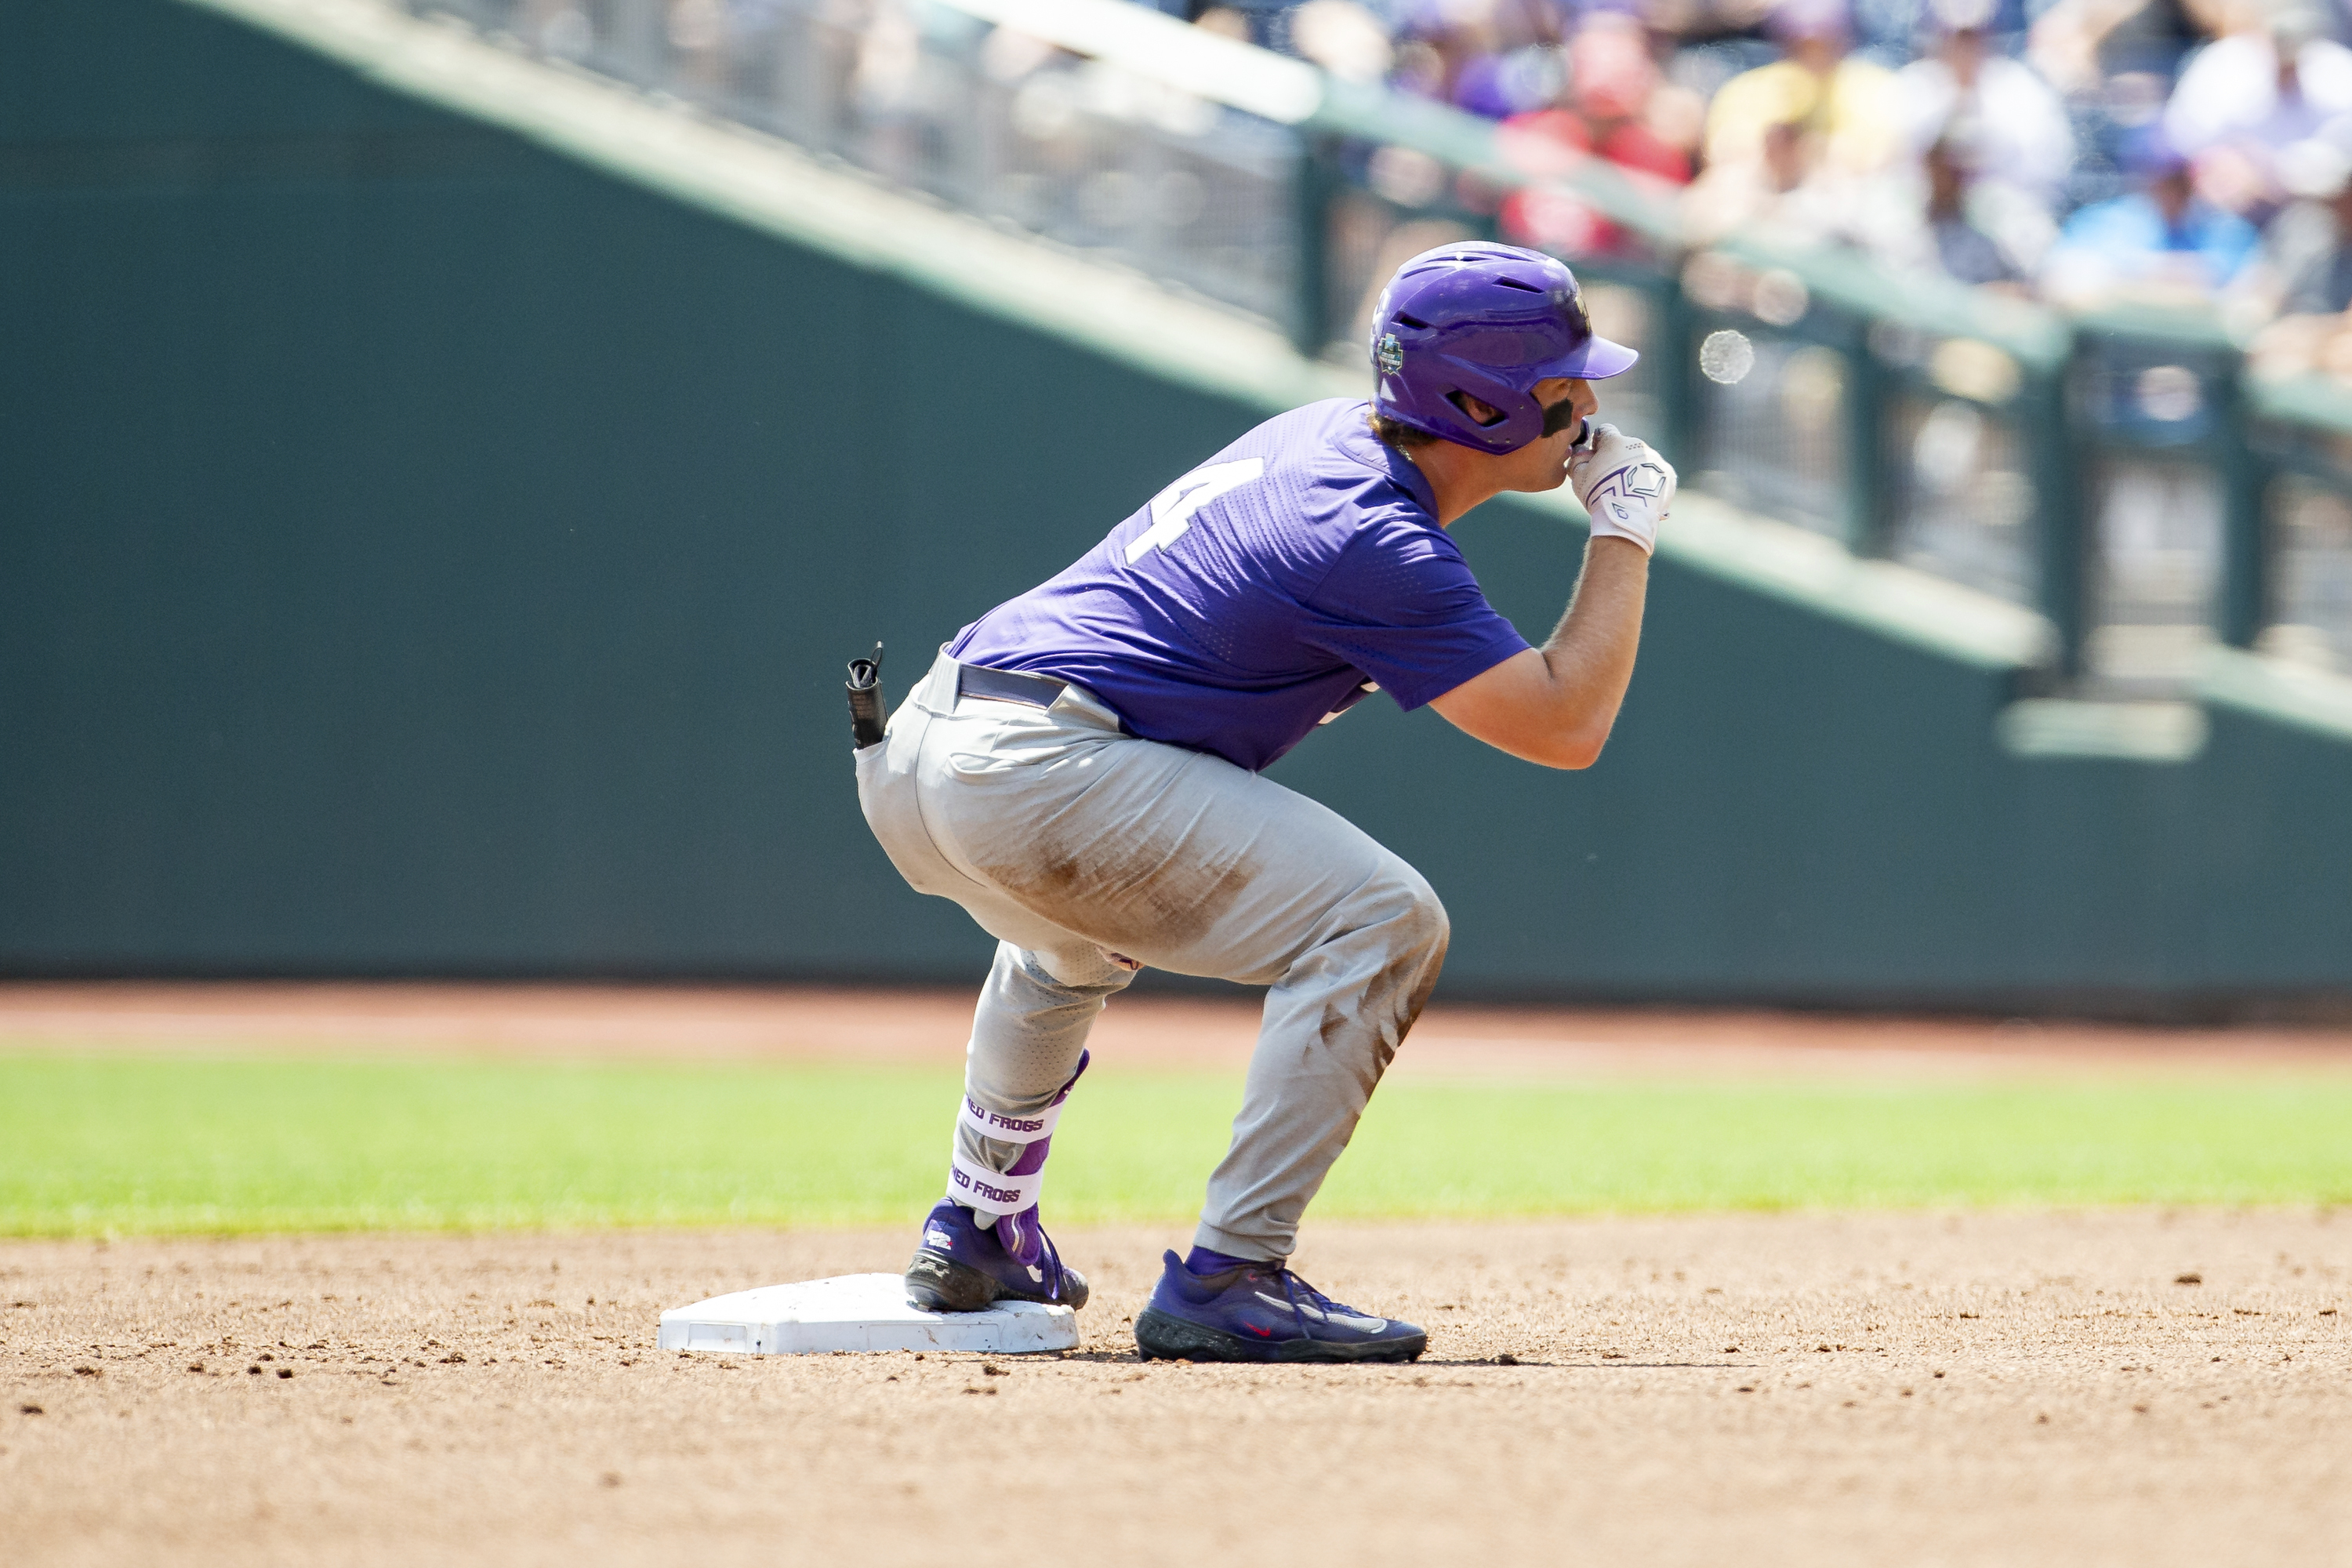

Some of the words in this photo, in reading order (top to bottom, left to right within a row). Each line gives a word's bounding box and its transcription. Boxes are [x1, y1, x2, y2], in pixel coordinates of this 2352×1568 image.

[1123, 456, 1265, 568] 4
[989, 1112, 1044, 1132] FROGS
[973, 1180, 1021, 1203] FROGS
